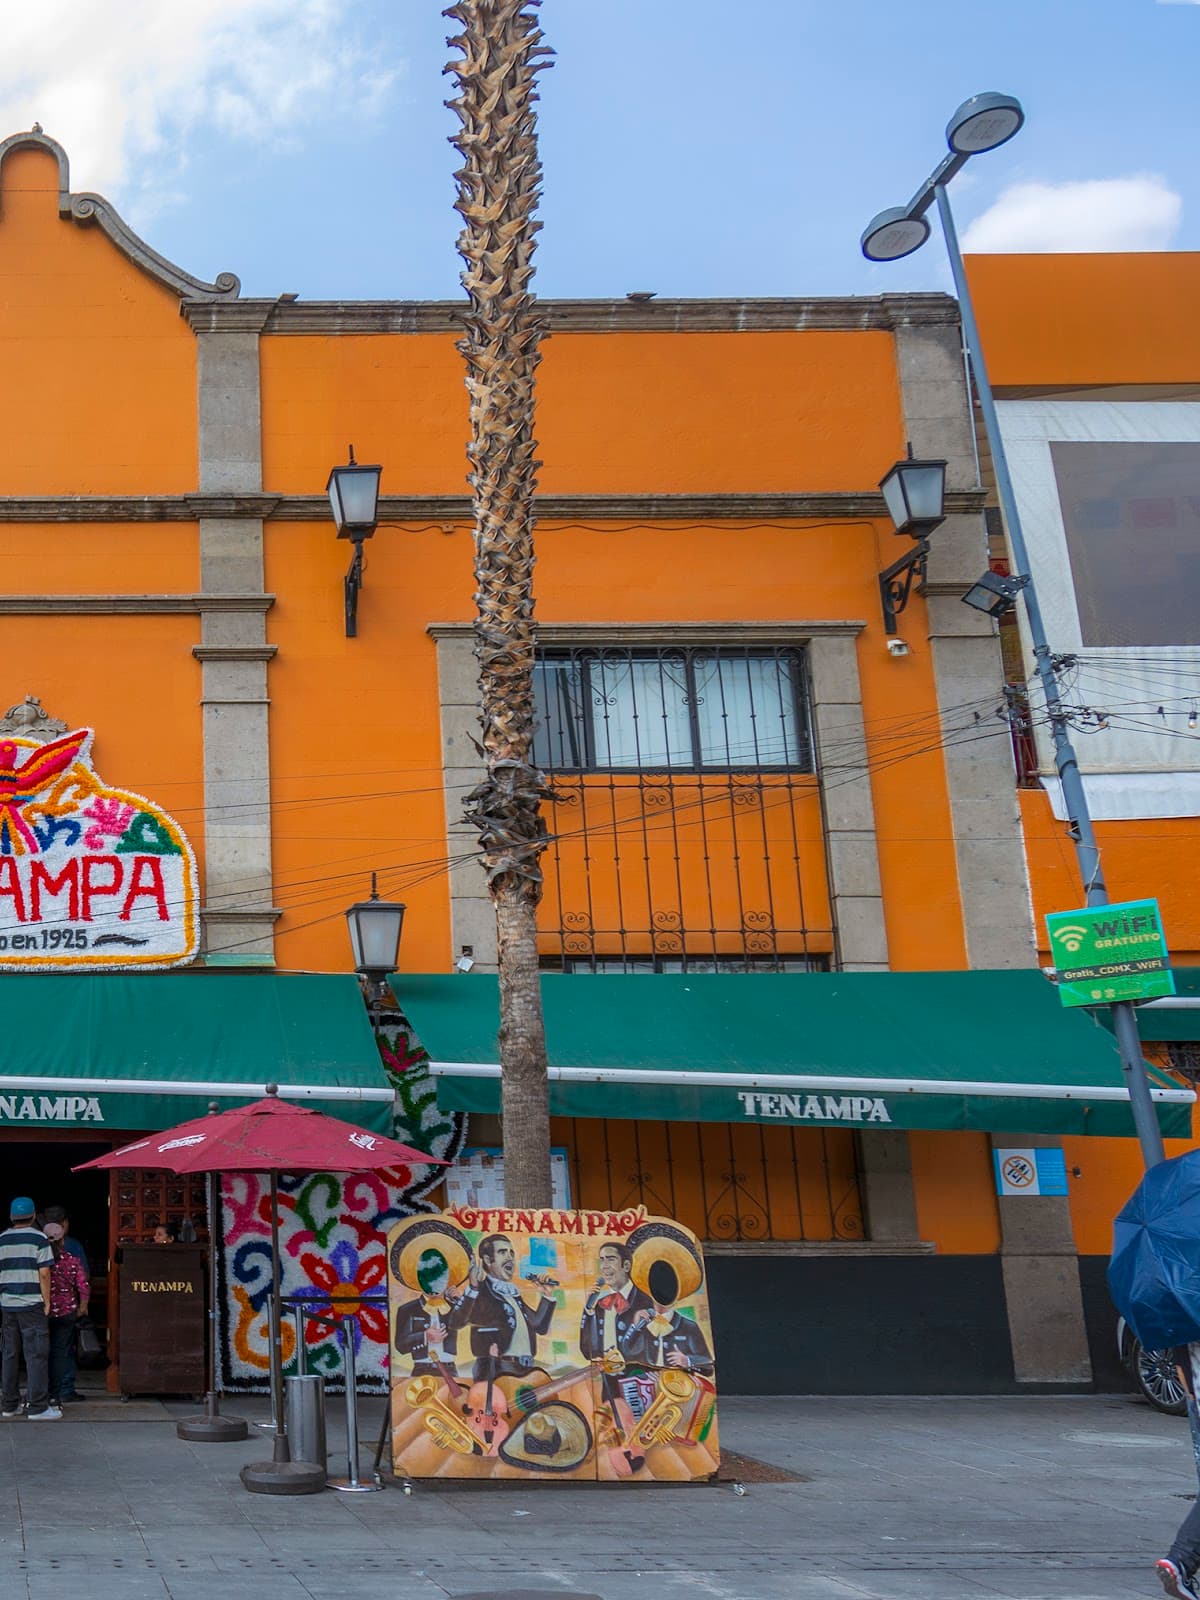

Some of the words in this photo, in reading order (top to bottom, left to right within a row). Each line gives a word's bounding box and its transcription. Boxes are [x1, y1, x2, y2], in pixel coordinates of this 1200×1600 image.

[1093, 913, 1159, 938] WiFi
[11, 933, 37, 950] en
[41, 928, 88, 949] 1925
[1095, 932, 1161, 949] GRATUITO
[737, 1091, 893, 1123] TENAMPA
[476, 1209, 626, 1237] TENAMPA
[131, 1281, 194, 1294] TENAMPA
